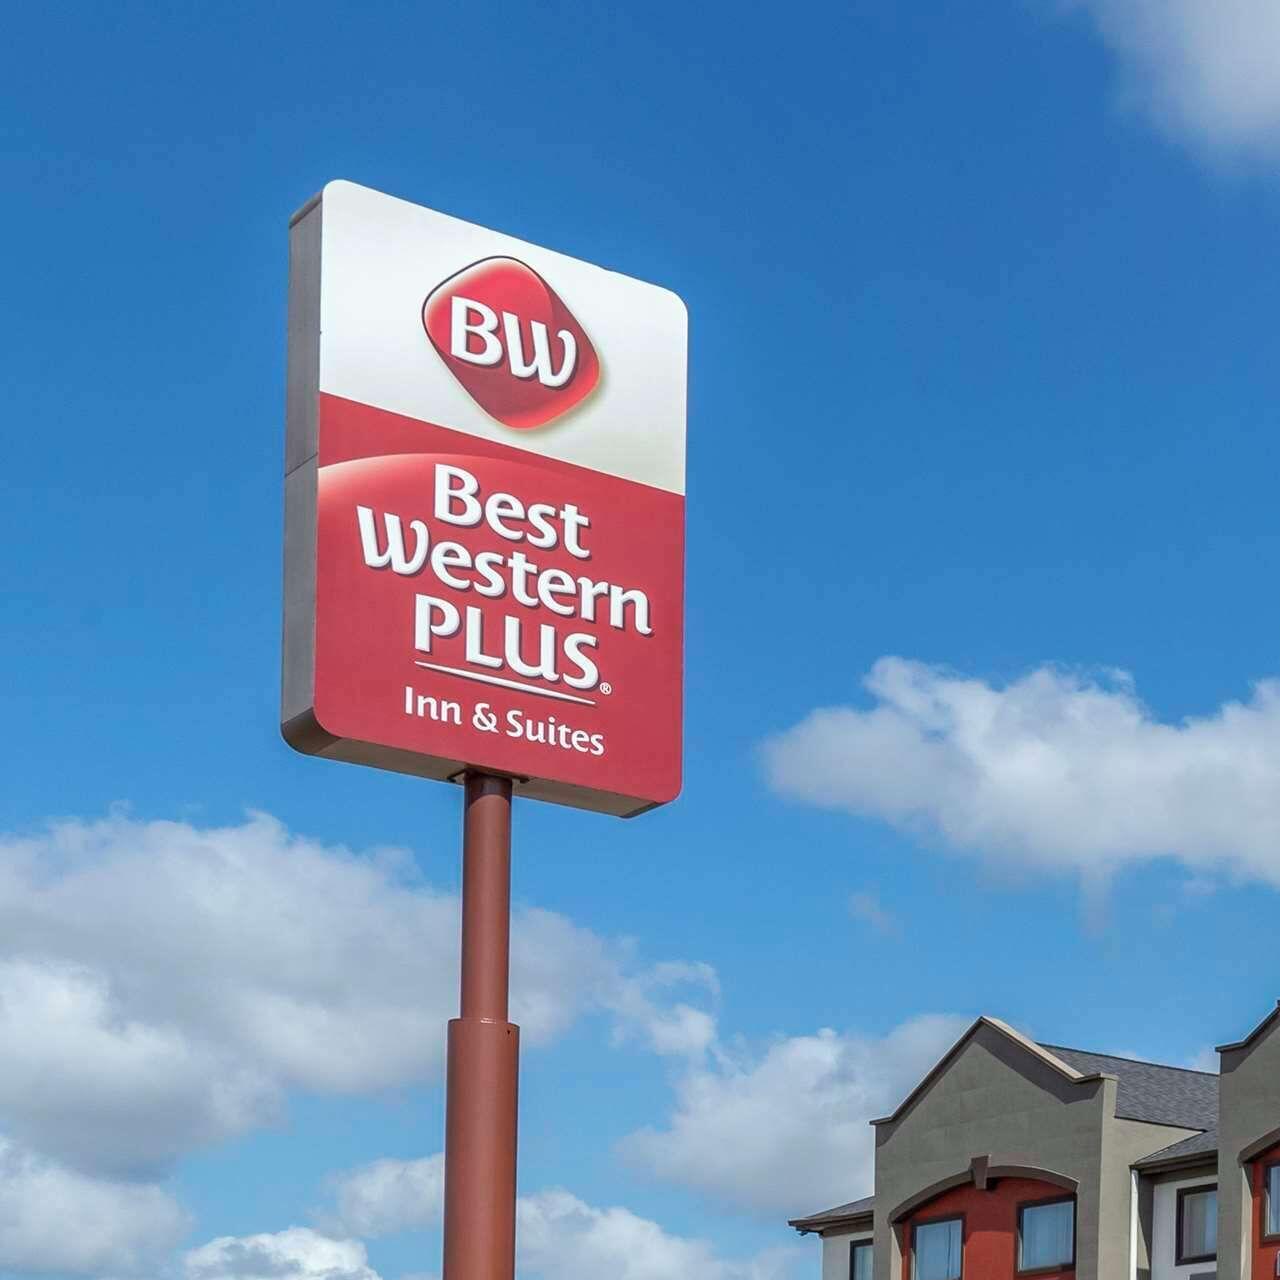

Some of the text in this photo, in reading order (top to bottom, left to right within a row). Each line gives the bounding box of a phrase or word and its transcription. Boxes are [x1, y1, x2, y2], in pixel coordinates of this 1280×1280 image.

[451, 296, 577, 387] BW
[434, 464, 591, 558] Best
[357, 505, 652, 635] Western
[404, 686, 605, 756] Inn & Suites
